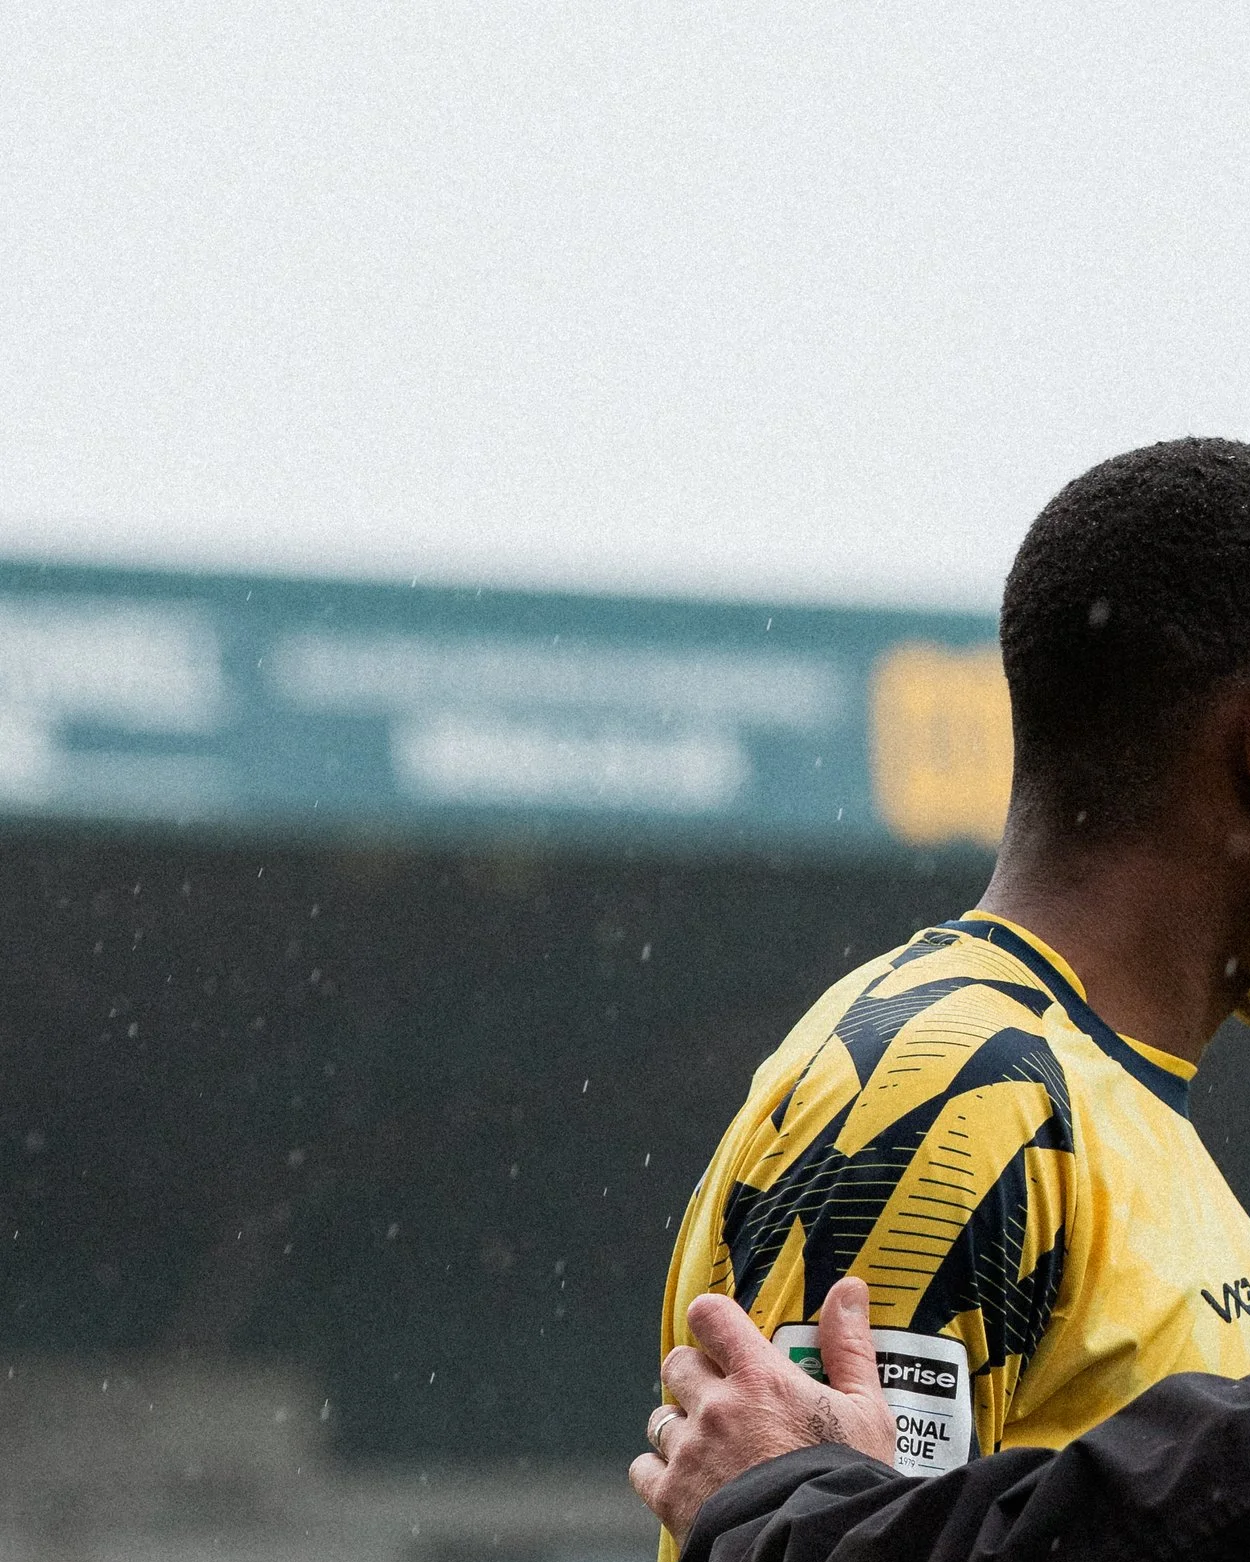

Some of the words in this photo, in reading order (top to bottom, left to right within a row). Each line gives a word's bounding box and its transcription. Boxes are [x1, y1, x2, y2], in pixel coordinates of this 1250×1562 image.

[895, 1414, 951, 1442] ONAL
[896, 1435, 936, 1460] GUE
[898, 1456, 916, 1468] 1979
